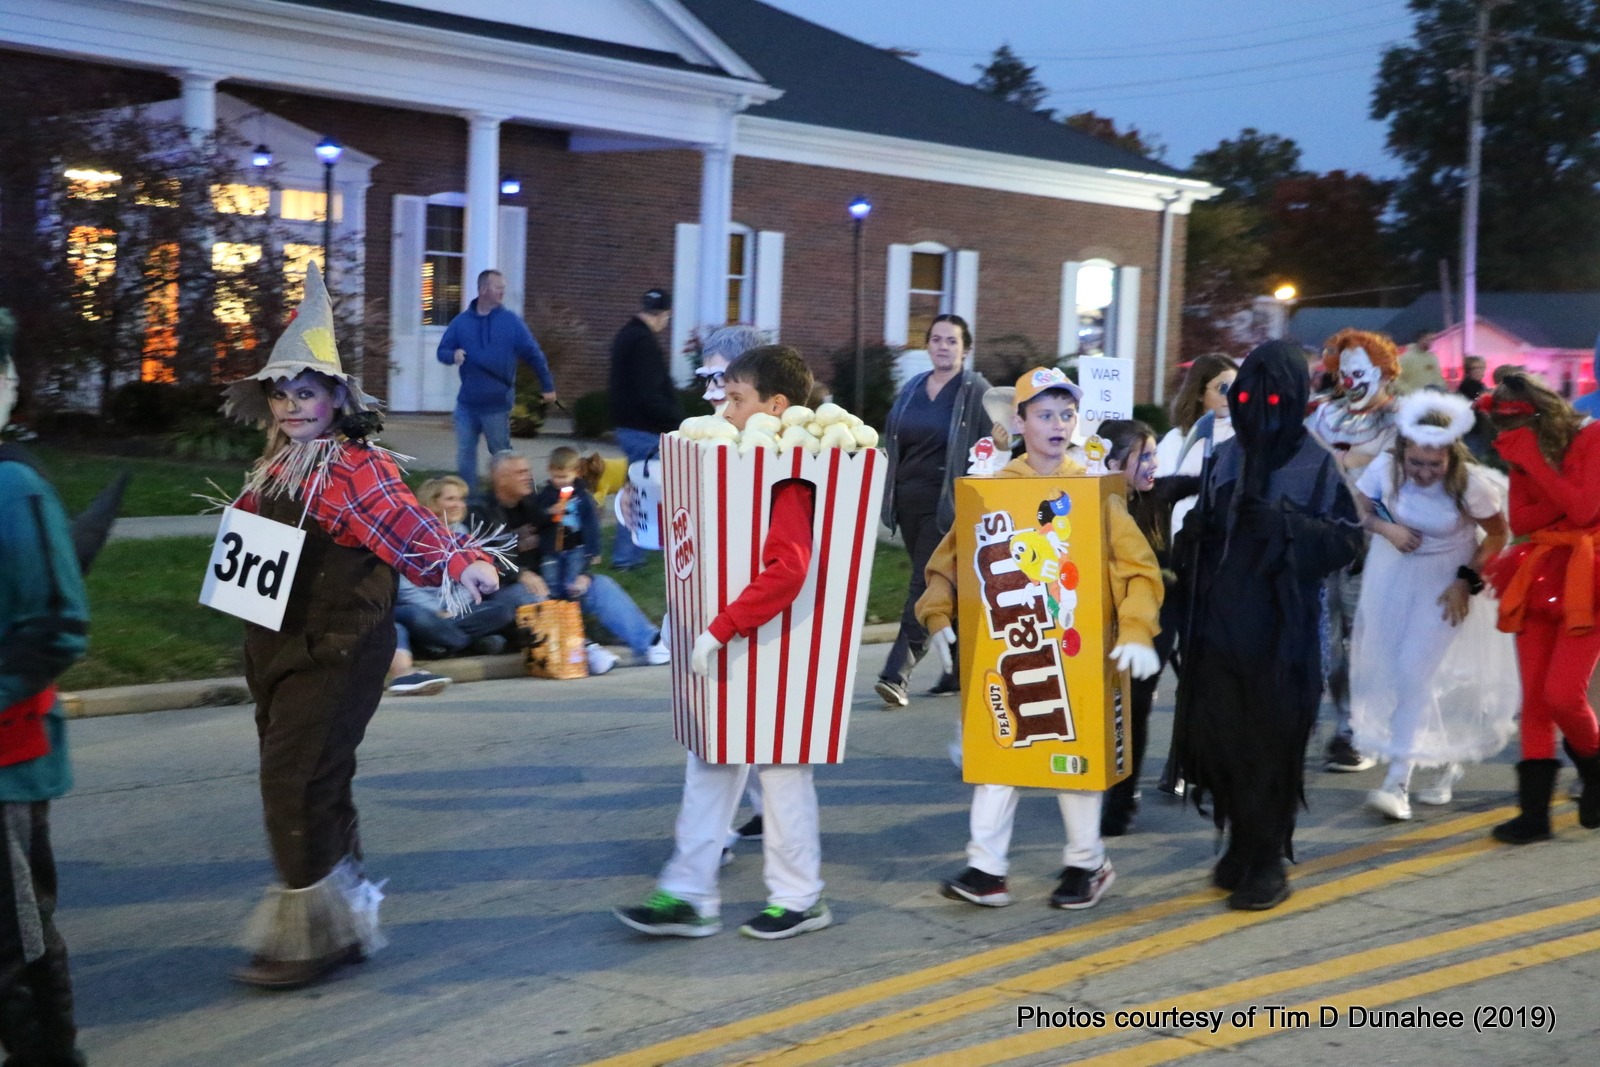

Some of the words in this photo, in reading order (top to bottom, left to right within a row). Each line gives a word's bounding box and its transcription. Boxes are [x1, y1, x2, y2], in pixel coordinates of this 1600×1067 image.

[1091, 368, 1120, 381] WAR
[1100, 389, 1112, 402] IS
[672, 512, 688, 546] POP
[213, 532, 290, 600] 3rd
[675, 536, 694, 574] CORN
[990, 685, 1010, 736] PEANUT
